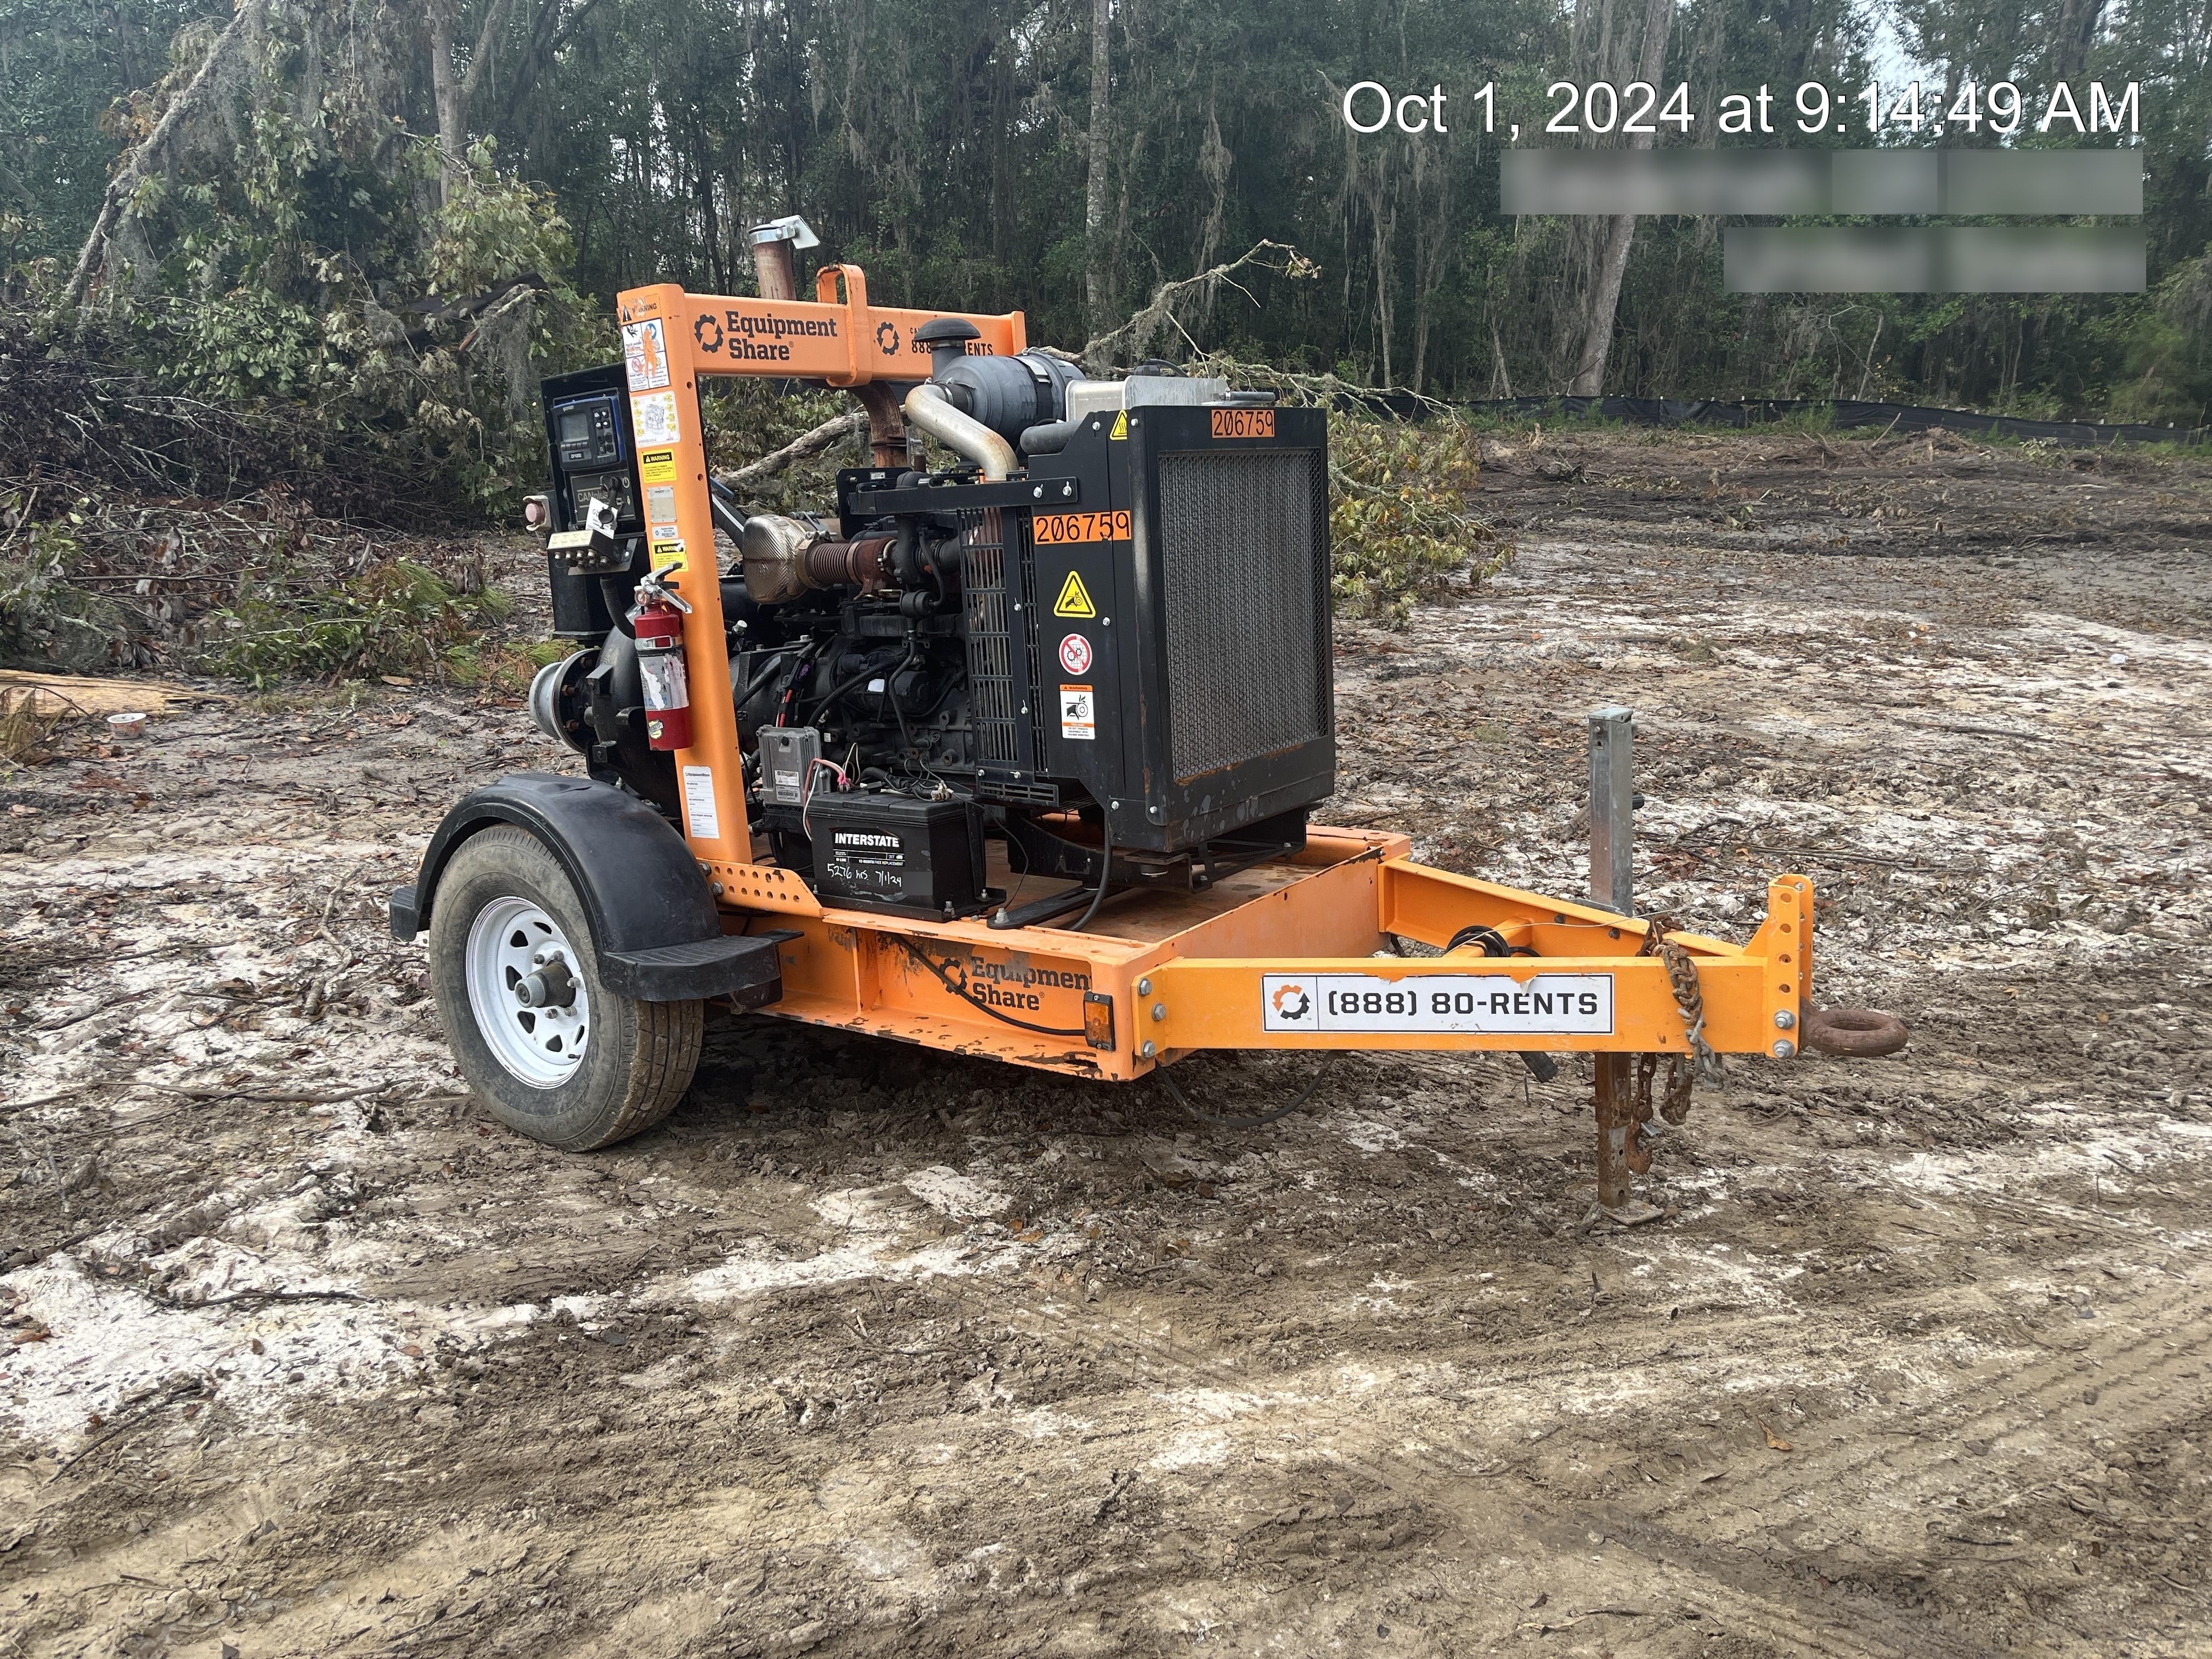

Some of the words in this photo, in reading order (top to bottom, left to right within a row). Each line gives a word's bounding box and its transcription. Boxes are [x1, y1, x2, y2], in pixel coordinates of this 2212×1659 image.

[725, 310, 838, 339] Equipment
[964, 342, 993, 356] ENTS
[1213, 410, 1273, 436] 206759
[1036, 512, 1130, 542] 206759
[835, 833, 900, 848] INTERSTATE
[827, 863, 852, 879] 5276
[1328, 990, 1418, 1016] (888)
[1431, 991, 1598, 1015] 80-RENTS
